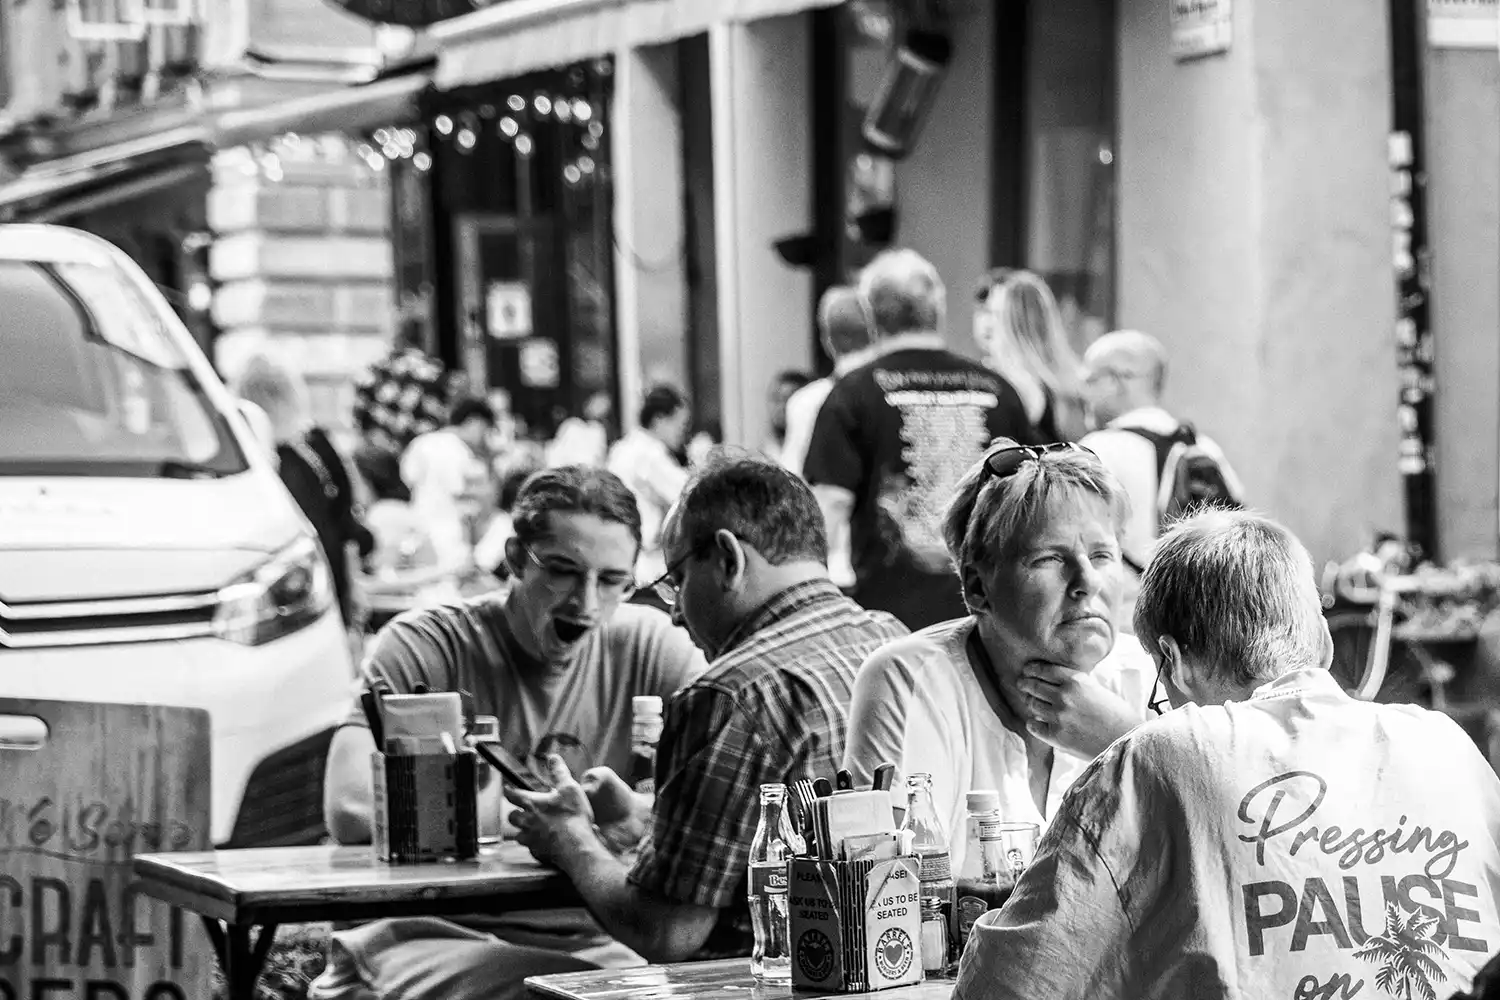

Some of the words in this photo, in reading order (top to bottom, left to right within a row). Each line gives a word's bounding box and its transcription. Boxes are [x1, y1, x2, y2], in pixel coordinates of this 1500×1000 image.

[1238, 771, 1468, 880] Pressing
[882, 896, 894, 907] US
[895, 894, 907, 905] TO
[908, 892, 918, 902] BE
[877, 907, 908, 920] SEATED
[1241, 874, 1489, 957] PAUSE
[877, 931, 911, 954] BARRELS
